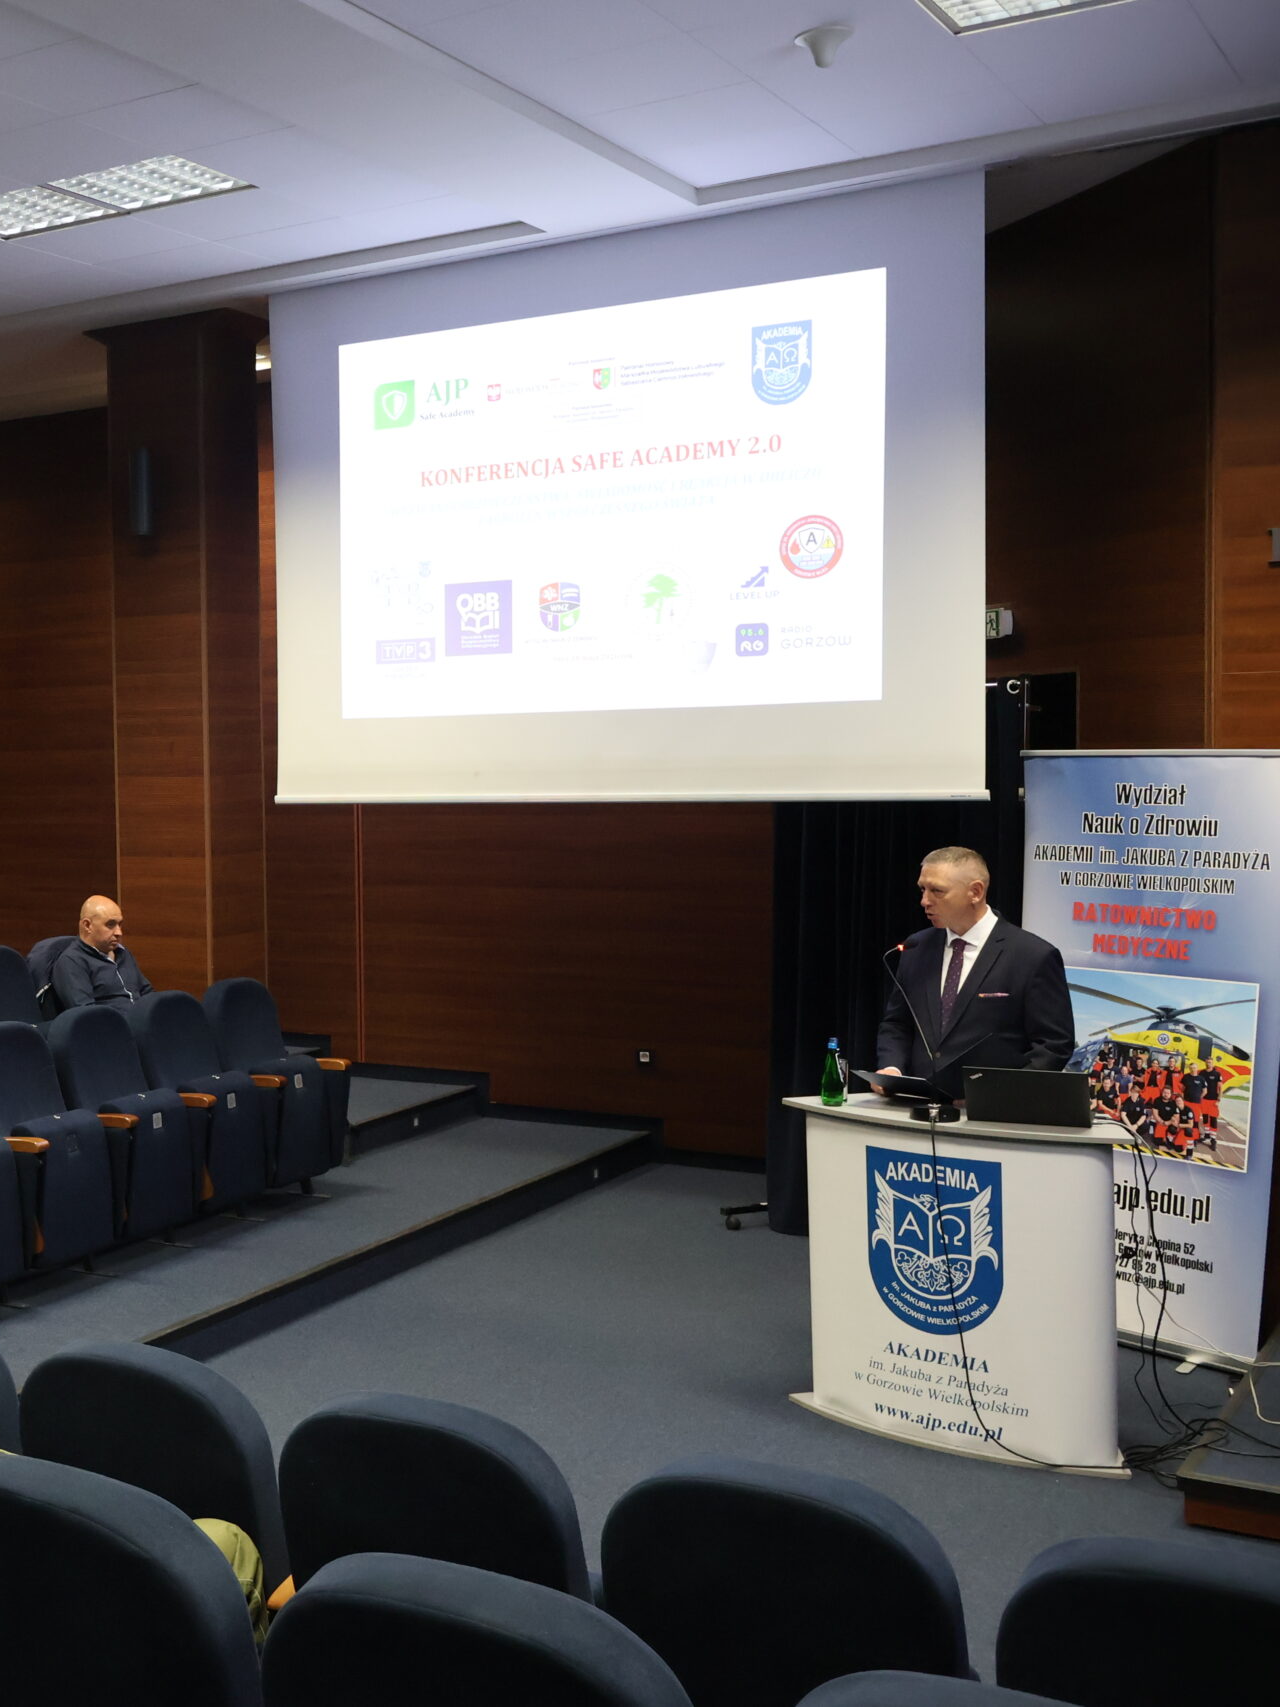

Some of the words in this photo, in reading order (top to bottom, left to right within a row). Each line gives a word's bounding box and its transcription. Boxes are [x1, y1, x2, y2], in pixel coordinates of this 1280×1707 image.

[761, 326, 803, 340] AKADEMIA
[426, 378, 470, 406] AJP
[420, 411, 437, 422] Safe
[438, 408, 475, 421] Academy
[420, 457, 566, 488] KONFERENCJA
[571, 450, 624, 473] SAFE
[630, 438, 741, 468] ACADEMY
[747, 433, 783, 456] 2.0
[550, 603, 569, 612] WNZ
[729, 591, 762, 601] LEVEL
[765, 590, 780, 599] UP
[780, 625, 813, 634] RADIO
[1116, 783, 1187, 808] Wydział
[1082, 812, 1124, 835] Nauk
[1129, 817, 1139, 835] o
[1144, 814, 1219, 837] Zdrowiu
[1034, 845, 1093, 862] AKADEMII
[1100, 847, 1118, 864] im.
[1123, 848, 1176, 867] JAKUBA
[1181, 850, 1189, 867] Z
[1193, 850, 1271, 871] PARADYŻA
[1060, 871, 1071, 886] W
[1075, 872, 1133, 889] GORZOWIE
[1137, 875, 1235, 894] WIELKOPOLSKIM
[1072, 901, 1217, 931] RATOWNICTWO
[1092, 933, 1192, 961] MEDYCZNE
[885, 1161, 980, 1193] AKADEMIA
[1184, 1243, 1195, 1256] 52
[1145, 1262, 1156, 1274] 28
[888, 1292, 926, 1322] GORZOWIE
[927, 1303, 990, 1326] WIELKOPOLSKIM
[901, 1290, 932, 1312] JAKUBA
[883, 1341, 990, 1373] AKADEMIA
[869, 1356, 886, 1372] im.
[890, 1362, 932, 1383] Jakuba
[936, 1377, 943, 1385] z
[947, 1375, 1009, 1397] Paradyża
[854, 1371, 864, 1381] w
[867, 1373, 924, 1398] Gorzowie
[928, 1388, 1030, 1418] Wielkopolskim
[874, 1402, 1004, 1442] www.ajp.edu.pl
